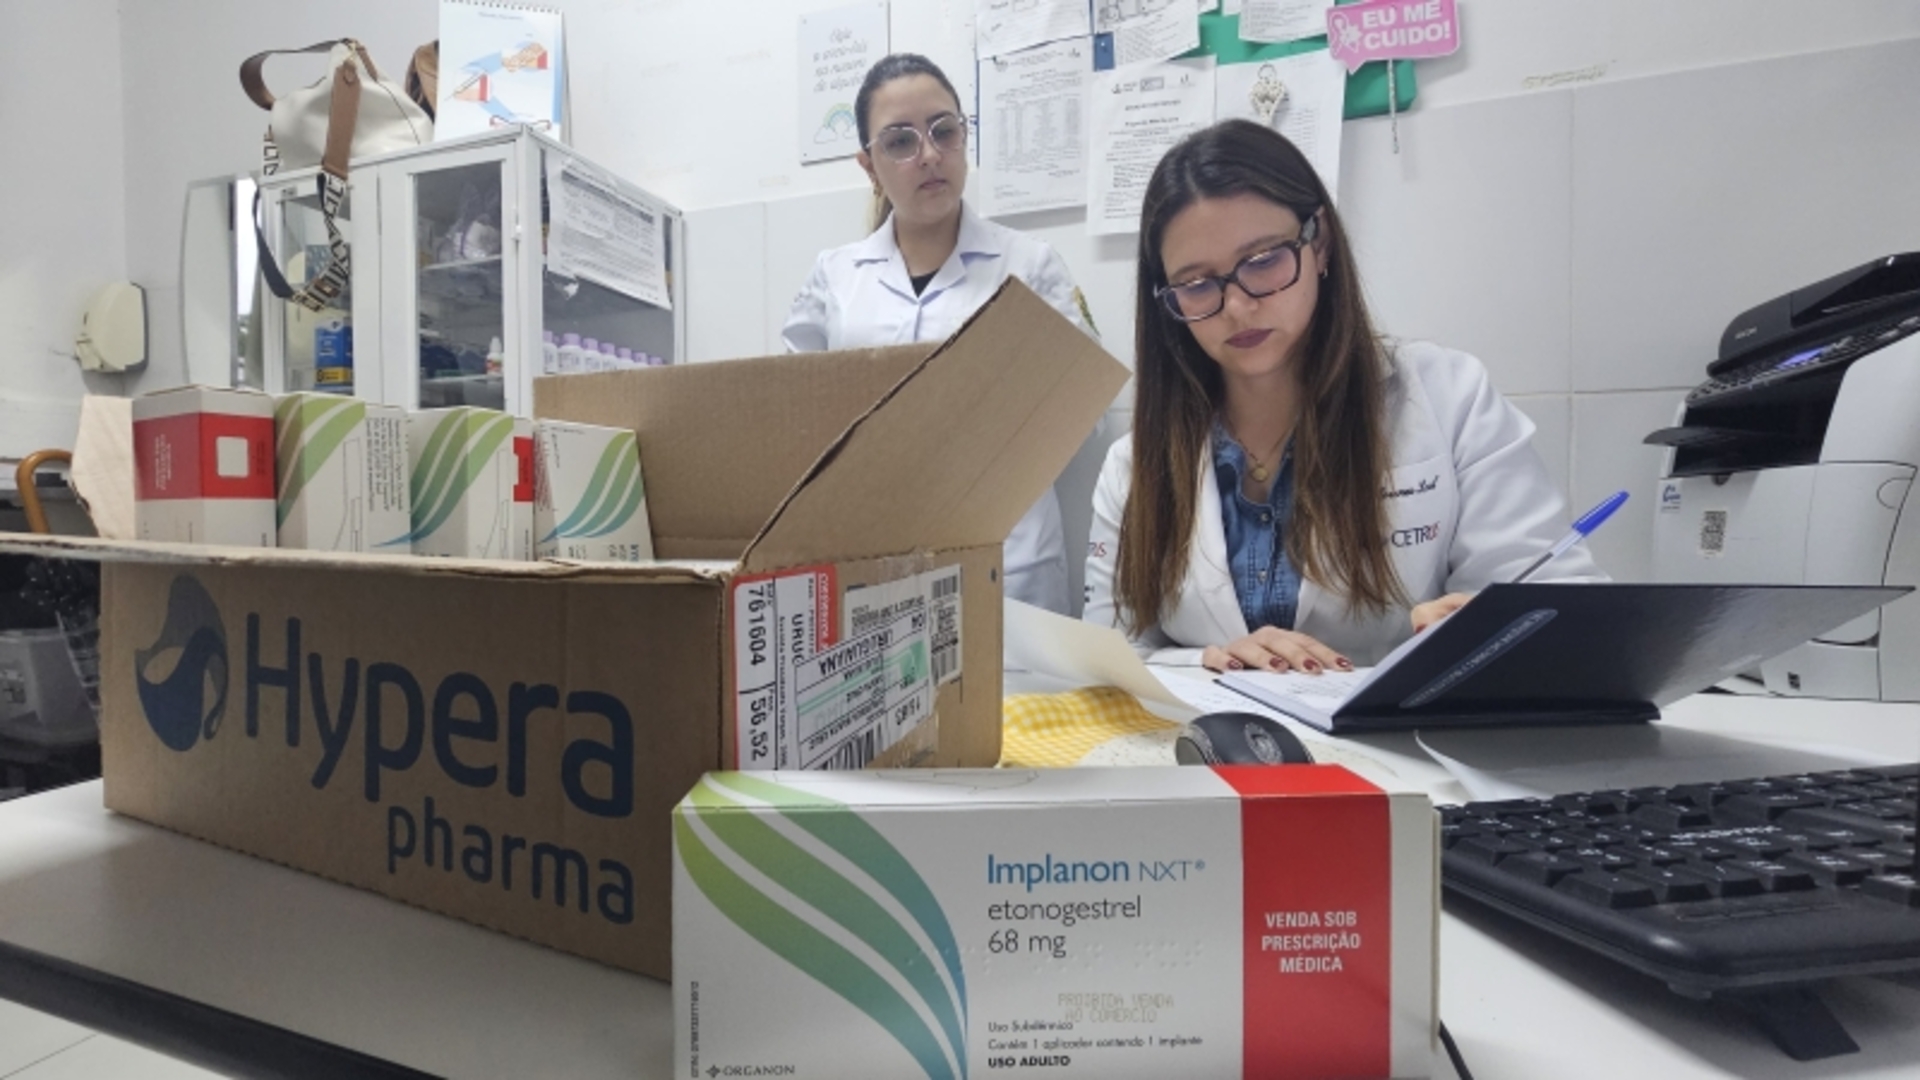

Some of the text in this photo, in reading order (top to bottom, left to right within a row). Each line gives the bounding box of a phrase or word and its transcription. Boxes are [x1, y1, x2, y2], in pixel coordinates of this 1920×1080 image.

[1362, 2, 1441, 29] EU ME
[1364, 22, 1450, 49] CUIDO!
[1391, 522, 1440, 548] CETRUS
[748, 585, 767, 666] 761604
[246, 612, 634, 818] Hypera
[749, 697, 768, 761] 56,52
[388, 796, 634, 924] pharma
[987, 854, 1130, 892] Implanon
[988, 895, 1141, 926] etonogestrel
[1265, 911, 1357, 929] VENDA SOB
[988, 930, 1066, 958] 68 mg
[1262, 930, 1361, 954] PRESCRIÇÃO
[1280, 952, 1343, 973] MÉDICA
[1058, 993, 1174, 1008] PROIBIDA VENDA
[988, 1021, 1008, 1032] Uso
[988, 1038, 1027, 1050] Contém
[1041, 1036, 1093, 1051] aplicador
[1096, 1036, 1144, 1048] contendo
[1159, 1034, 1203, 1049] implante
[724, 1064, 795, 1077] ORGANON
[988, 1055, 1071, 1068] USO ADULTO
